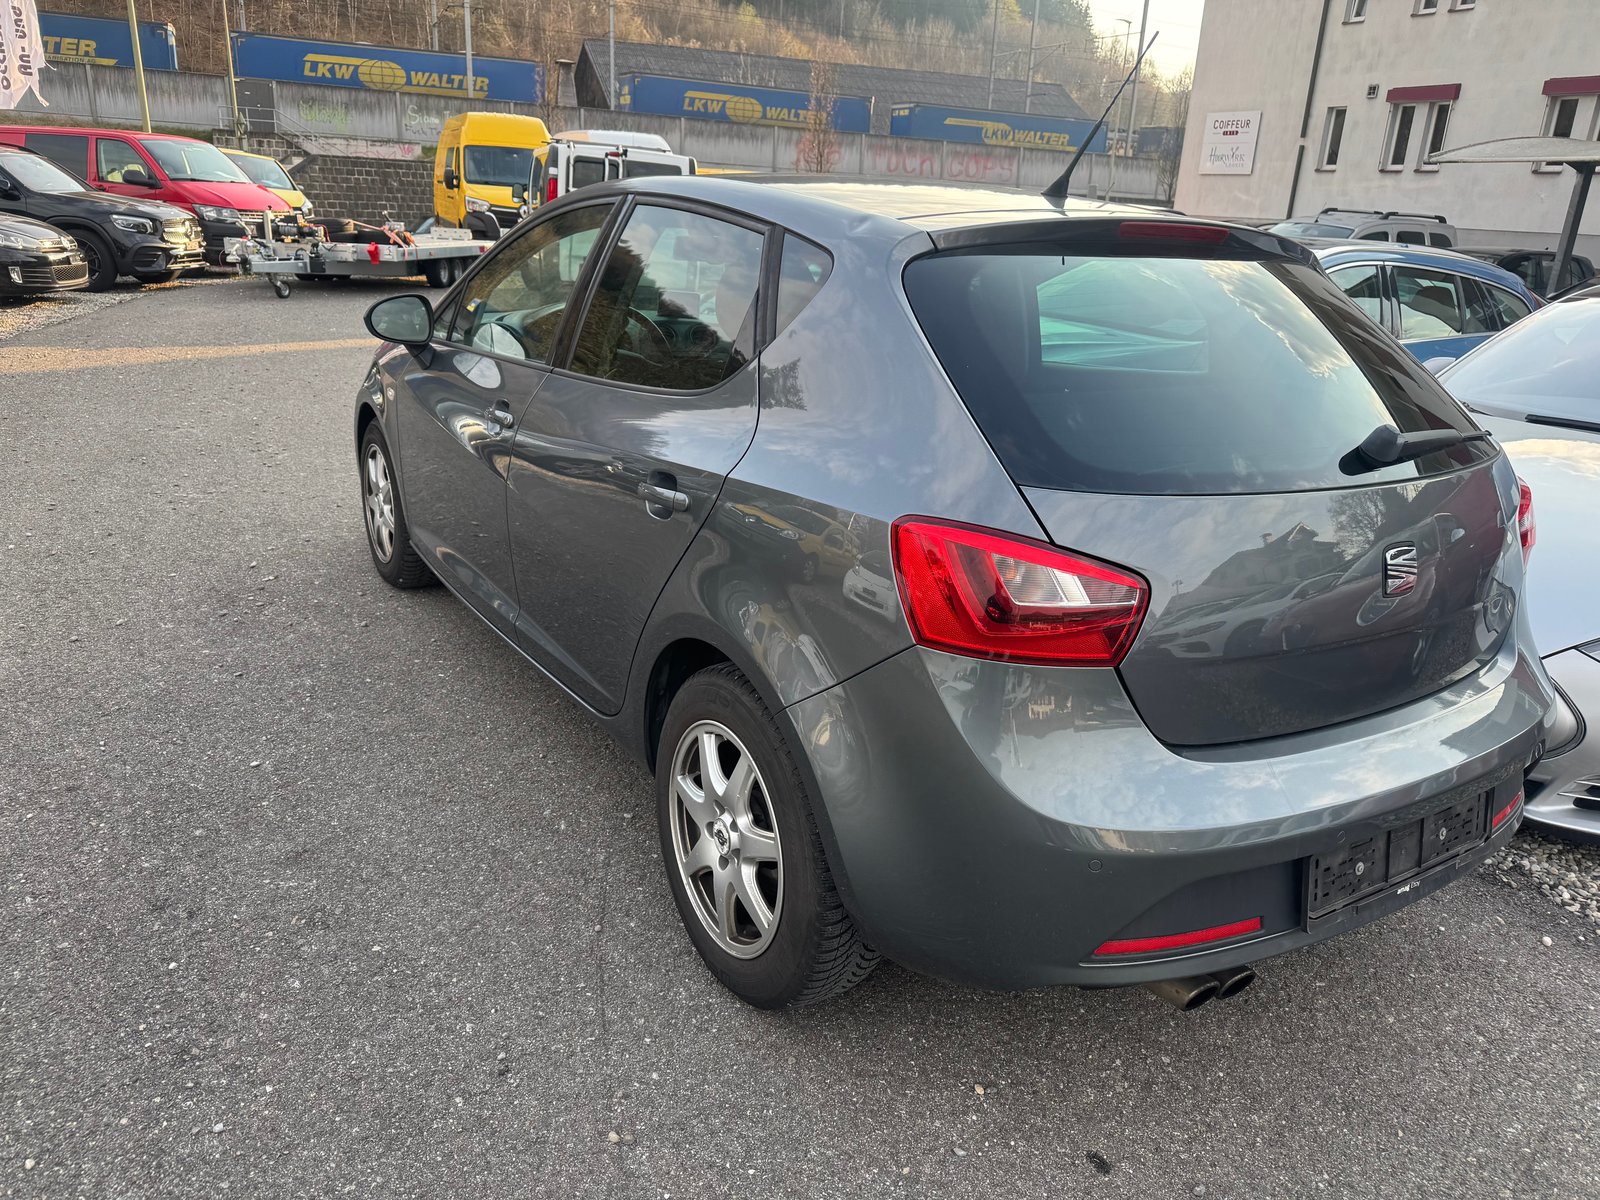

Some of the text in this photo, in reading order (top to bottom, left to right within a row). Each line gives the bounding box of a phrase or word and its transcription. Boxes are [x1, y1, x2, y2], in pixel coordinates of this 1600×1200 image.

[43, 35, 97, 57] TER
[303, 61, 355, 80] LKW
[683, 98, 724, 114] LKW
[1213, 119, 1251, 130] COIFFEUR
[983, 127, 1070, 146] LKW WALTER
